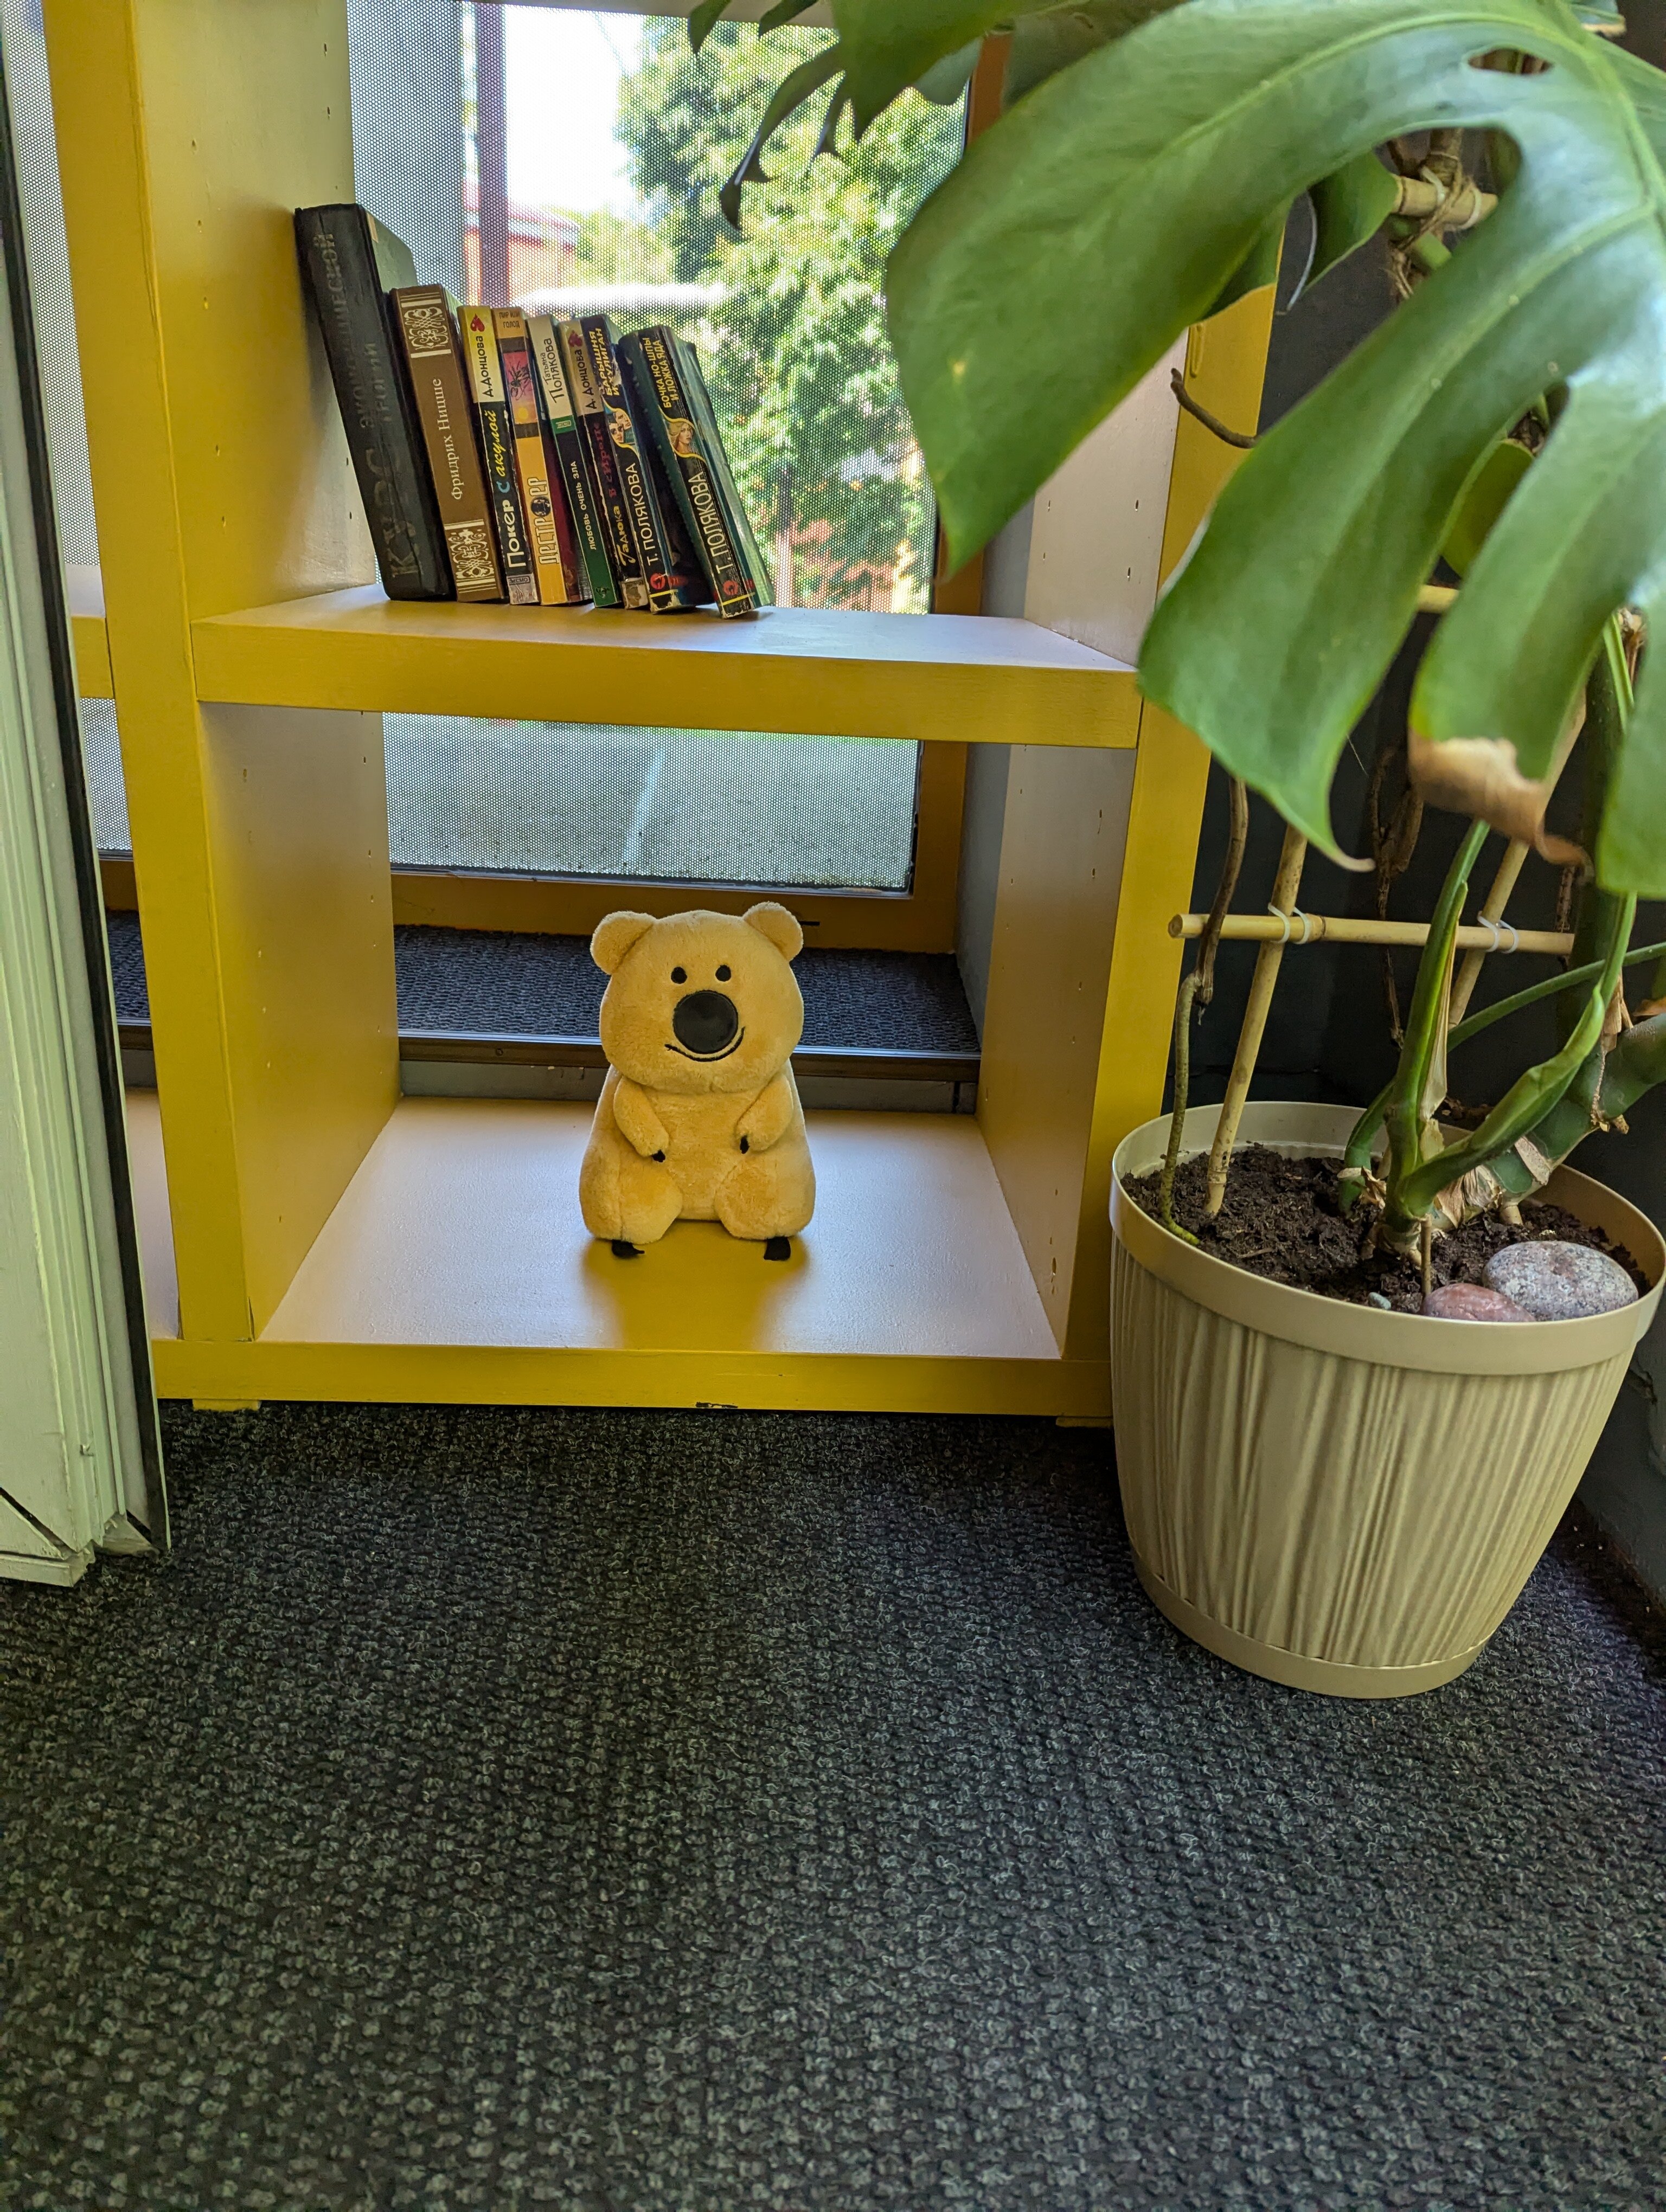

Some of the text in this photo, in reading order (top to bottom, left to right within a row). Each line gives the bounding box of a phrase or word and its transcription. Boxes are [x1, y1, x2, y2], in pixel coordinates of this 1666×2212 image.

[540, 352, 552, 384] Татьяна
[544, 338, 565, 403] Полякова
[574, 349, 597, 409] Д. Донцова
[589, 331, 613, 396] БАРЫШНЯ
[643, 338, 672, 408] БОЧКА НО-ШПЫ
[653, 340, 665, 359] ЯДА
[661, 360, 677, 392] ЛОЖКА
[610, 385, 620, 396] И
[432, 378, 465, 500] Фридрих Ницше
[484, 410, 506, 477] акулой
[571, 461, 597, 550] ЛЮБОВЬ ОЧЕНЬ ЗЛА
[613, 505, 636, 566] Гадюка
[626, 462, 658, 566] Т. ПОЛЯКОВА
[688, 471, 733, 574] Т. ПОЛЯКОВА
